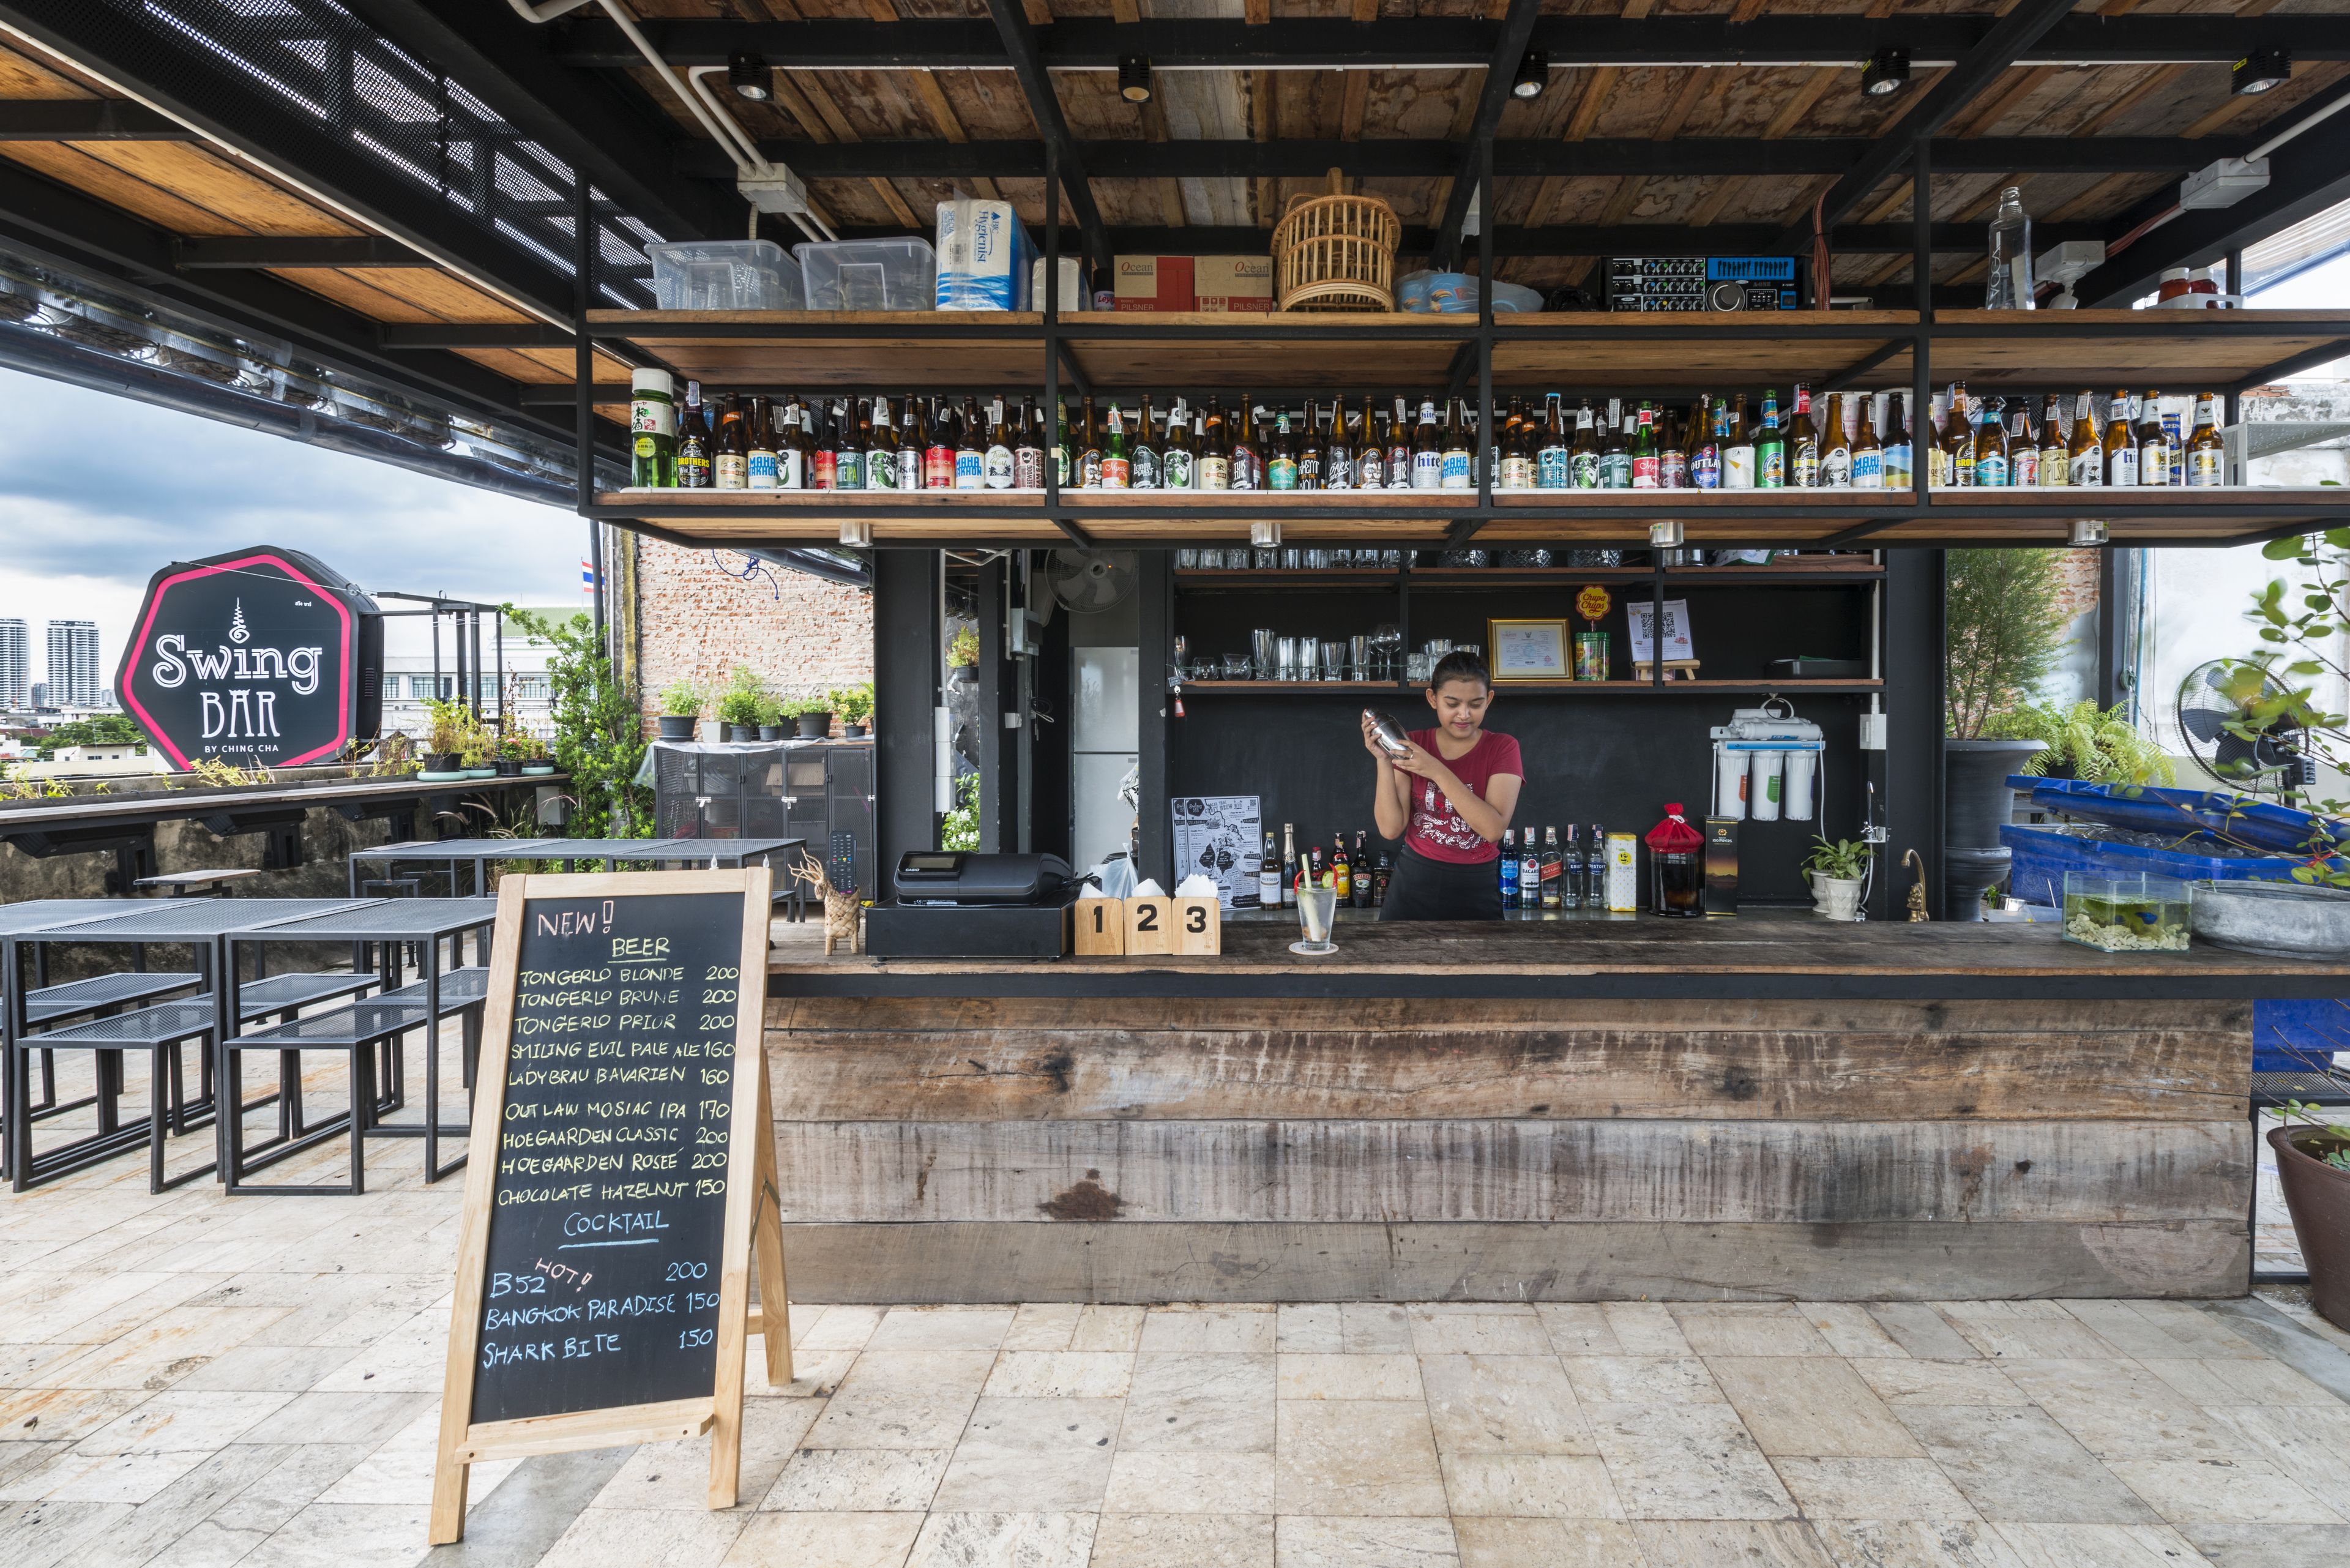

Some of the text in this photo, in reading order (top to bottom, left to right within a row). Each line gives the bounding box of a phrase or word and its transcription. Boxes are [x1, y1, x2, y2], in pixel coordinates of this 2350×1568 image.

[1121, 262, 1153, 272] Ocean
[1235, 261, 1269, 273] Ocean
[677, 457, 709, 468] BROTHERS
[750, 456, 776, 466] MAHA
[1234, 460, 1246, 471] TUK
[1393, 461, 1406, 471] TUK
[1417, 454, 1440, 468] hite
[1443, 457, 1467, 468] MAHA
[2124, 450, 2136, 463] hi
[846, 466, 857, 482] IPA
[897, 464, 920, 474] Asahi
[1105, 463, 1127, 473] Mystic
[1329, 461, 1349, 476] DARK
[1442, 466, 1469, 479] NAKHON
[1614, 468, 1628, 483] WHITE
[1581, 601, 1605, 610] Chups
[1583, 593, 1606, 602] Chupa
[153, 634, 322, 695] Swing
[200, 689, 280, 738] BAR
[1094, 906, 1103, 933] 1
[1136, 904, 1158, 931] 2
[1186, 906, 1206, 933] 3
[611, 937, 671, 958] BEER
[520, 966, 739, 987] TONGERLO BLONDE 200
[517, 989, 737, 1008] TONGERLO BRUNE 200
[514, 1014, 736, 1035] TONGERLO PRIOR 200
[512, 1041, 736, 1060] SMILING EVIL PALE ALE 160
[596, 1066, 686, 1084] BAVARIEN
[700, 1068, 730, 1086] 160
[588, 1101, 650, 1117] MOSIAC
[660, 1103, 687, 1119] IPA
[699, 1103, 731, 1121] 170
[503, 1127, 728, 1151] HOEGAARDEN CLASSIC 200
[501, 1154, 623, 1175] HOEGAARDEN
[692, 1152, 728, 1169] 200
[498, 1179, 726, 1207] CHOCOLATE HAZELNUT 150
[564, 1210, 670, 1237] COCKTAIL
[490, 1262, 708, 1298] B52 200
[535, 1258, 593, 1293] HOT!
[485, 1293, 720, 1331] BANGKOK PARADISE 150
[483, 1328, 714, 1370] SHARK BITE 150
